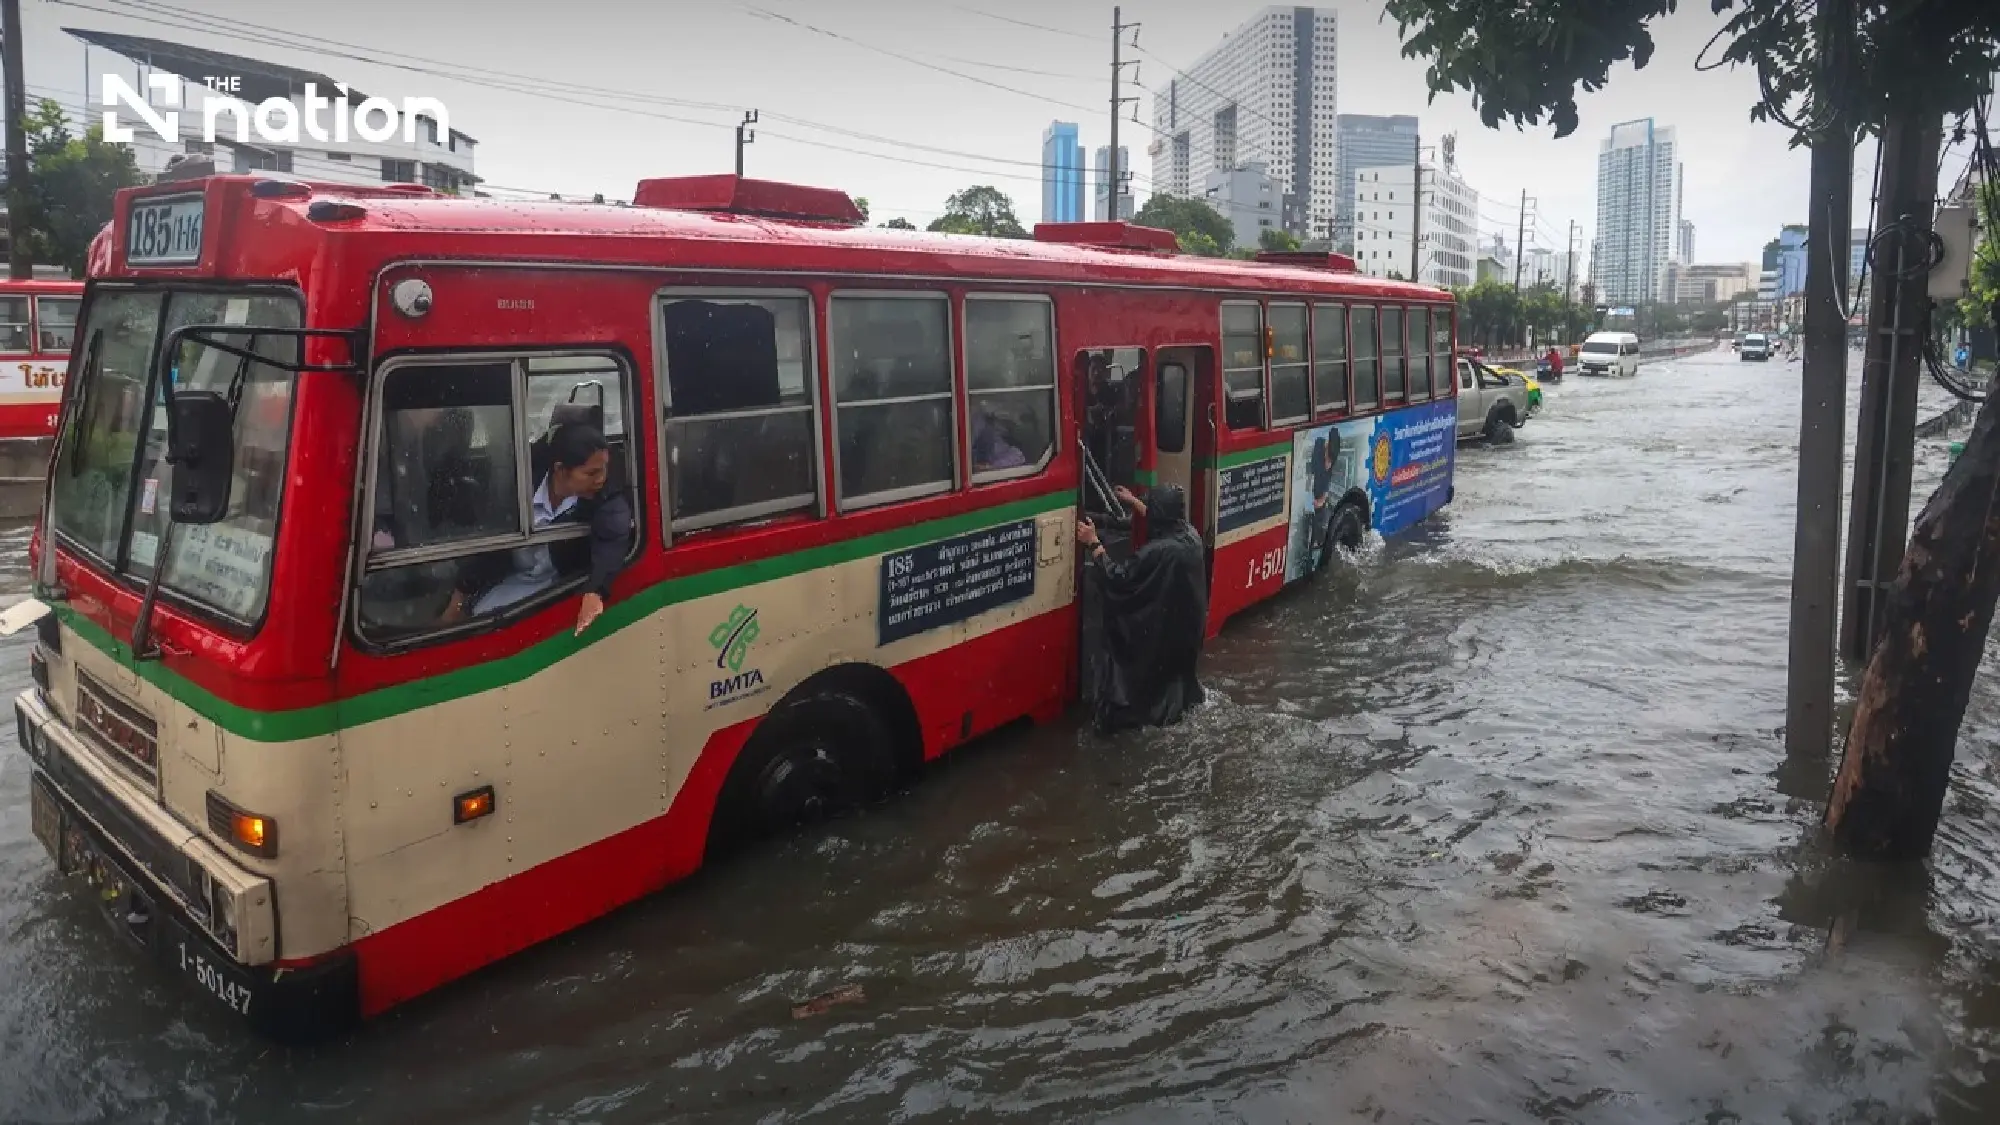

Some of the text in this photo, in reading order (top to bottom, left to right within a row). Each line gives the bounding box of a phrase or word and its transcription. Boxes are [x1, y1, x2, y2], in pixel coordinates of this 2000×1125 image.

[888, 553, 914, 578] 185
[710, 668, 764, 700] BMTA
[178, 942, 252, 1016] 1-50147
